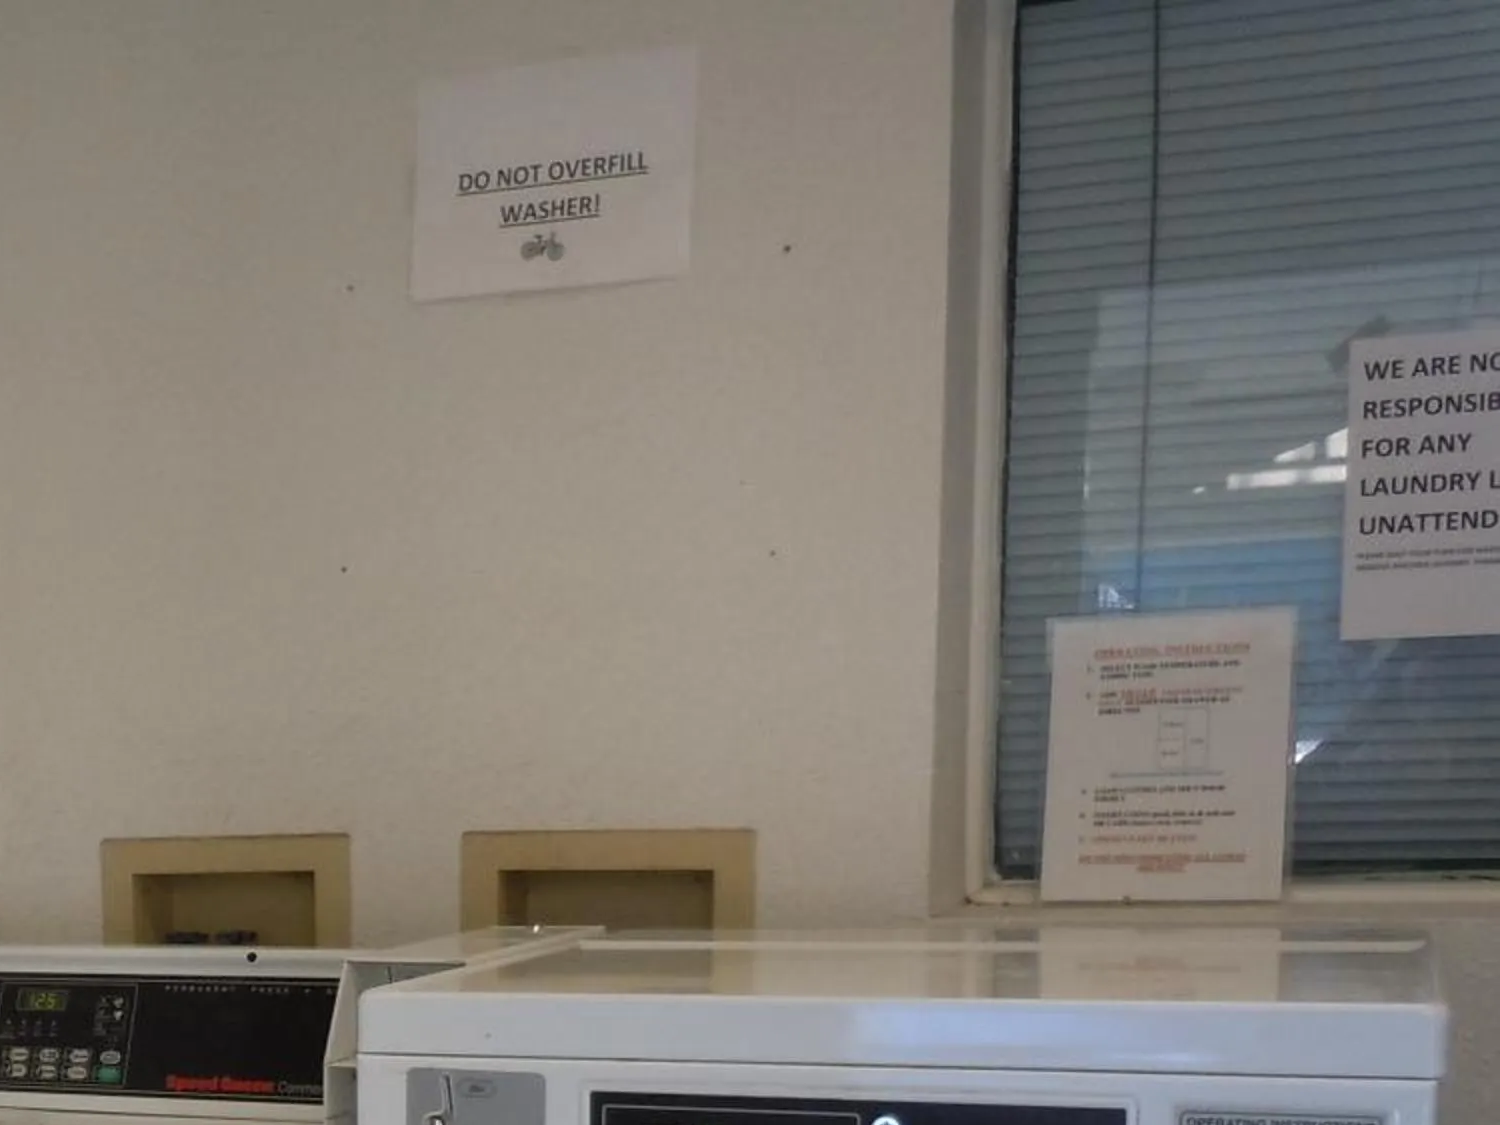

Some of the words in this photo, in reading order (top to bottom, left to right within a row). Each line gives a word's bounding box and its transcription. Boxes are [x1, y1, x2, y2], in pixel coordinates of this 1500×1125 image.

[458, 171, 490, 193] DO
[496, 163, 543, 187] NOT
[547, 151, 649, 181] OVERFILL
[500, 193, 601, 224] WASHER!
[1363, 359, 1404, 382] WE
[1411, 354, 1462, 378] ARE
[1362, 391, 1500, 420] RESPONSIB
[1360, 436, 1411, 460] FOR
[1417, 432, 1473, 456] ANY
[1359, 470, 1482, 498] LAUNDRY
[1358, 509, 1499, 536] UNATTEND
